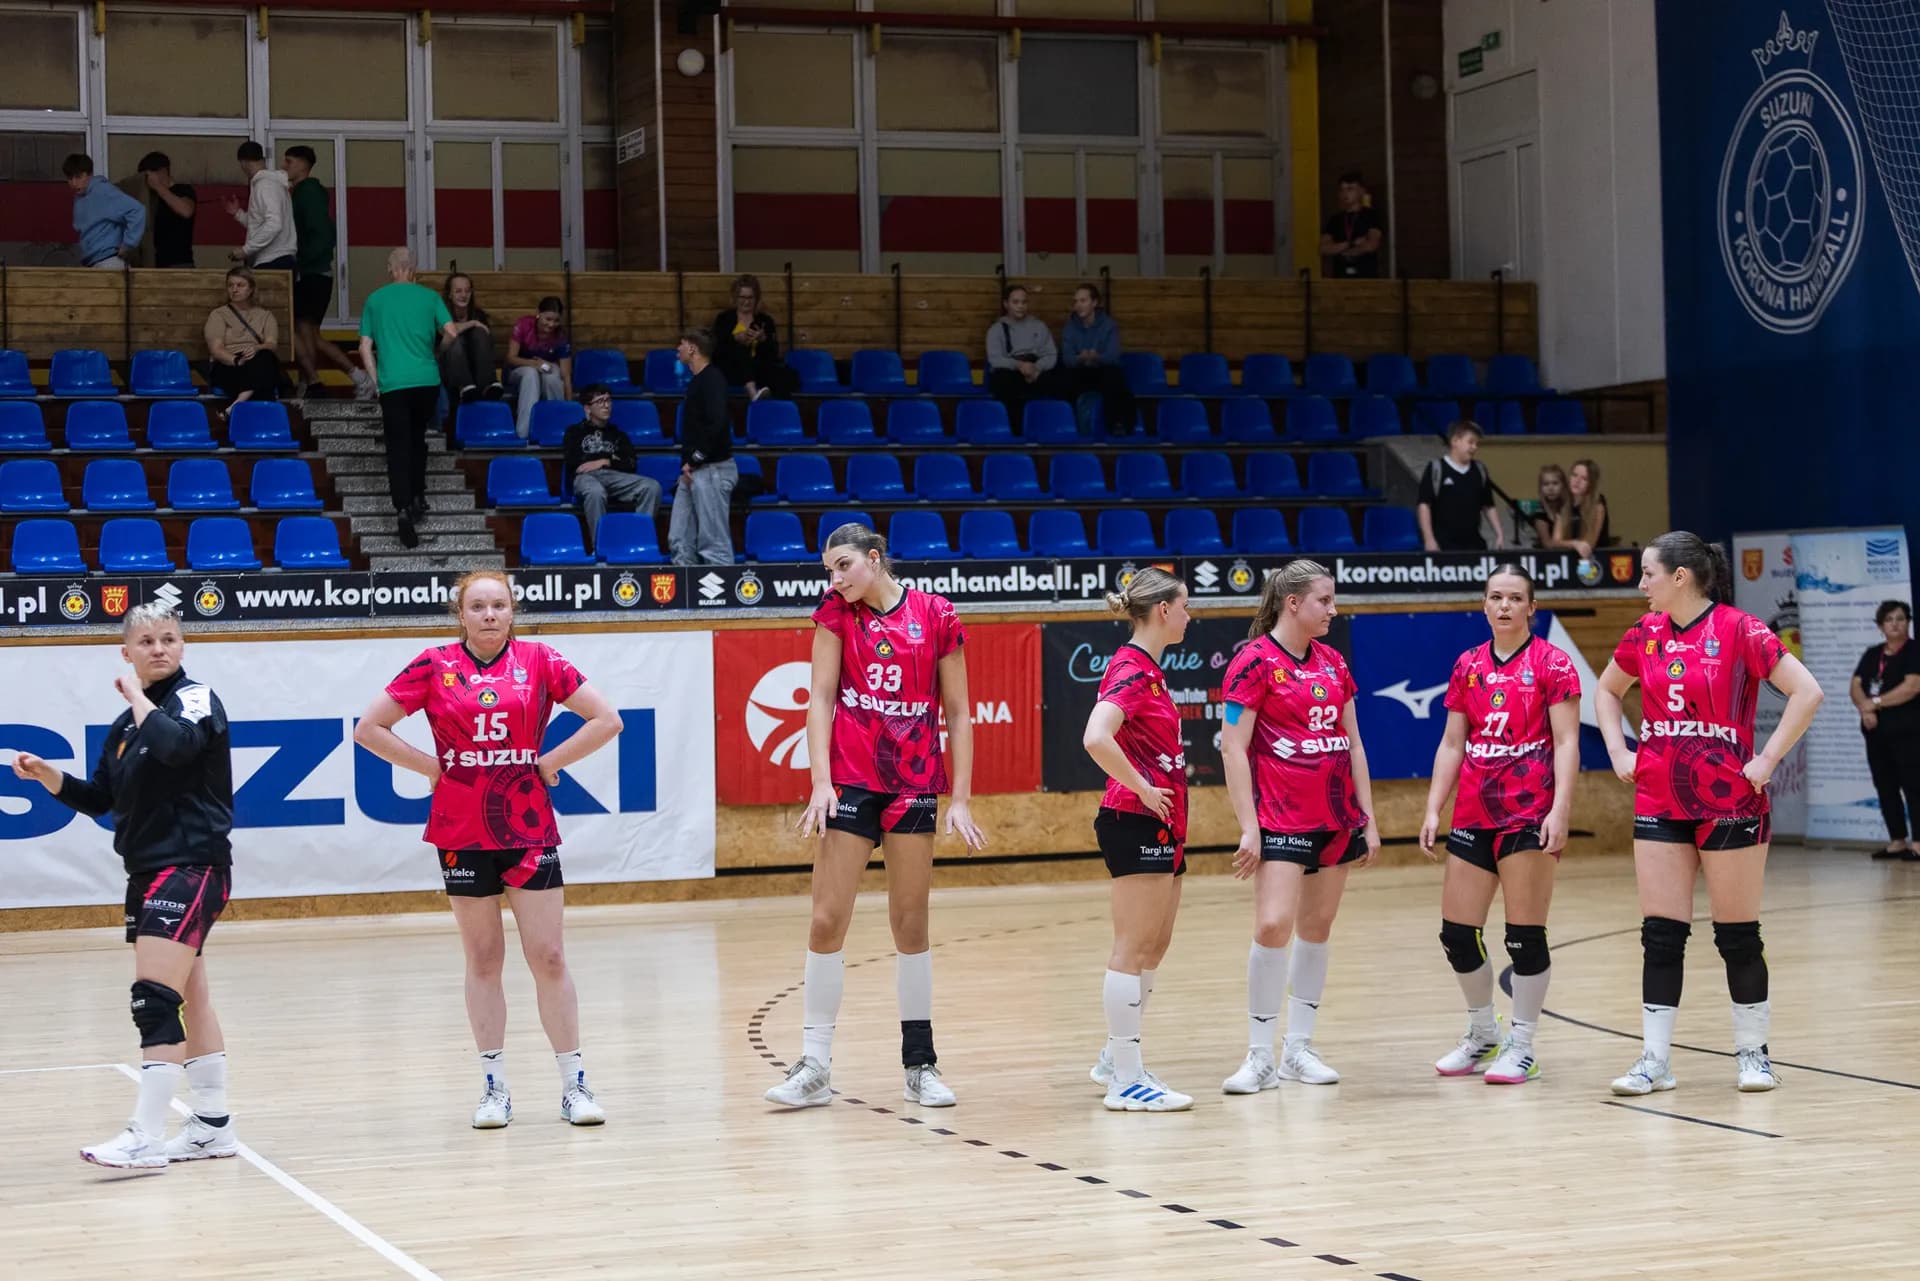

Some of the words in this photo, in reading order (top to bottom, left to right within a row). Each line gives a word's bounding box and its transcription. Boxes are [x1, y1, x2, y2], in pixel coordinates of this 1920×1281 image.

[1760, 91, 1814, 129] SUZUKI
[1735, 233, 1786, 311] KORONA
[1789, 211, 1849, 311] HANDBALL
[866, 663, 902, 692] 33
[859, 694, 929, 717] SUZUK
[1667, 684, 1684, 712] 5
[472, 712, 508, 742] 15
[1308, 705, 1338, 732] 32
[1480, 711, 1510, 737] 17
[1301, 735, 1350, 755] SUZU
[1654, 720, 1737, 745] SUZUKI
[837, 802, 858, 813] ielce
[1140, 846, 1161, 857] Targi
[1265, 835, 1286, 845] Targi
[1288, 836, 1313, 848] Kielce
